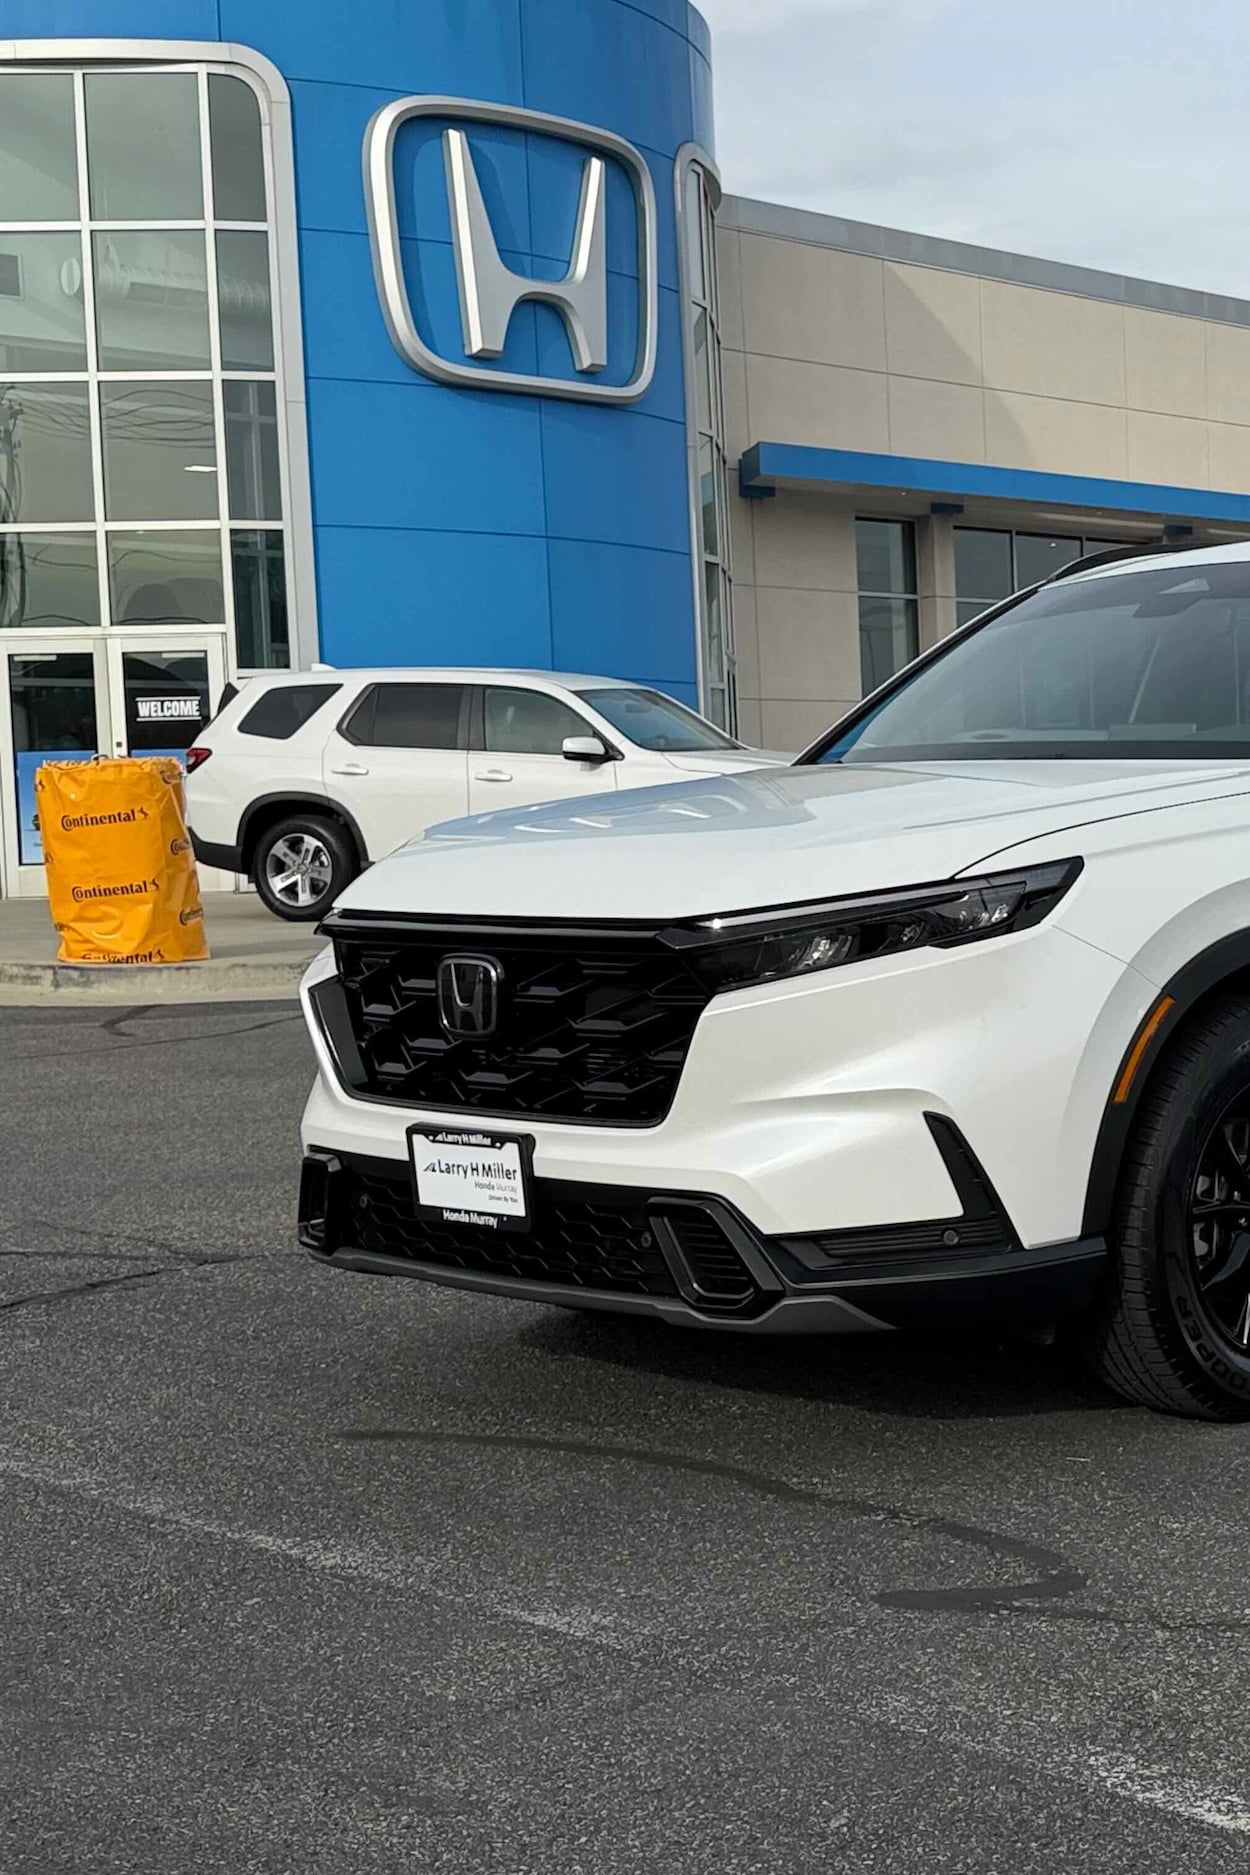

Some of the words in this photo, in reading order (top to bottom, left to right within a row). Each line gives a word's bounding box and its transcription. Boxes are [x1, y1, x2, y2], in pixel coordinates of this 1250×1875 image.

[137, 700, 200, 718] WELCOME
[61, 808, 137, 832] Continental
[72, 880, 149, 903] Continental
[441, 1132, 463, 1145] Larry
[470, 1134, 492, 1146] Miller
[438, 1159, 468, 1180] Larry
[470, 1162, 479, 1177] H
[482, 1163, 518, 1181] Miller
[474, 1181, 496, 1191] Honda
[443, 1209, 470, 1223] Honda
[470, 1212, 498, 1230] Murray
